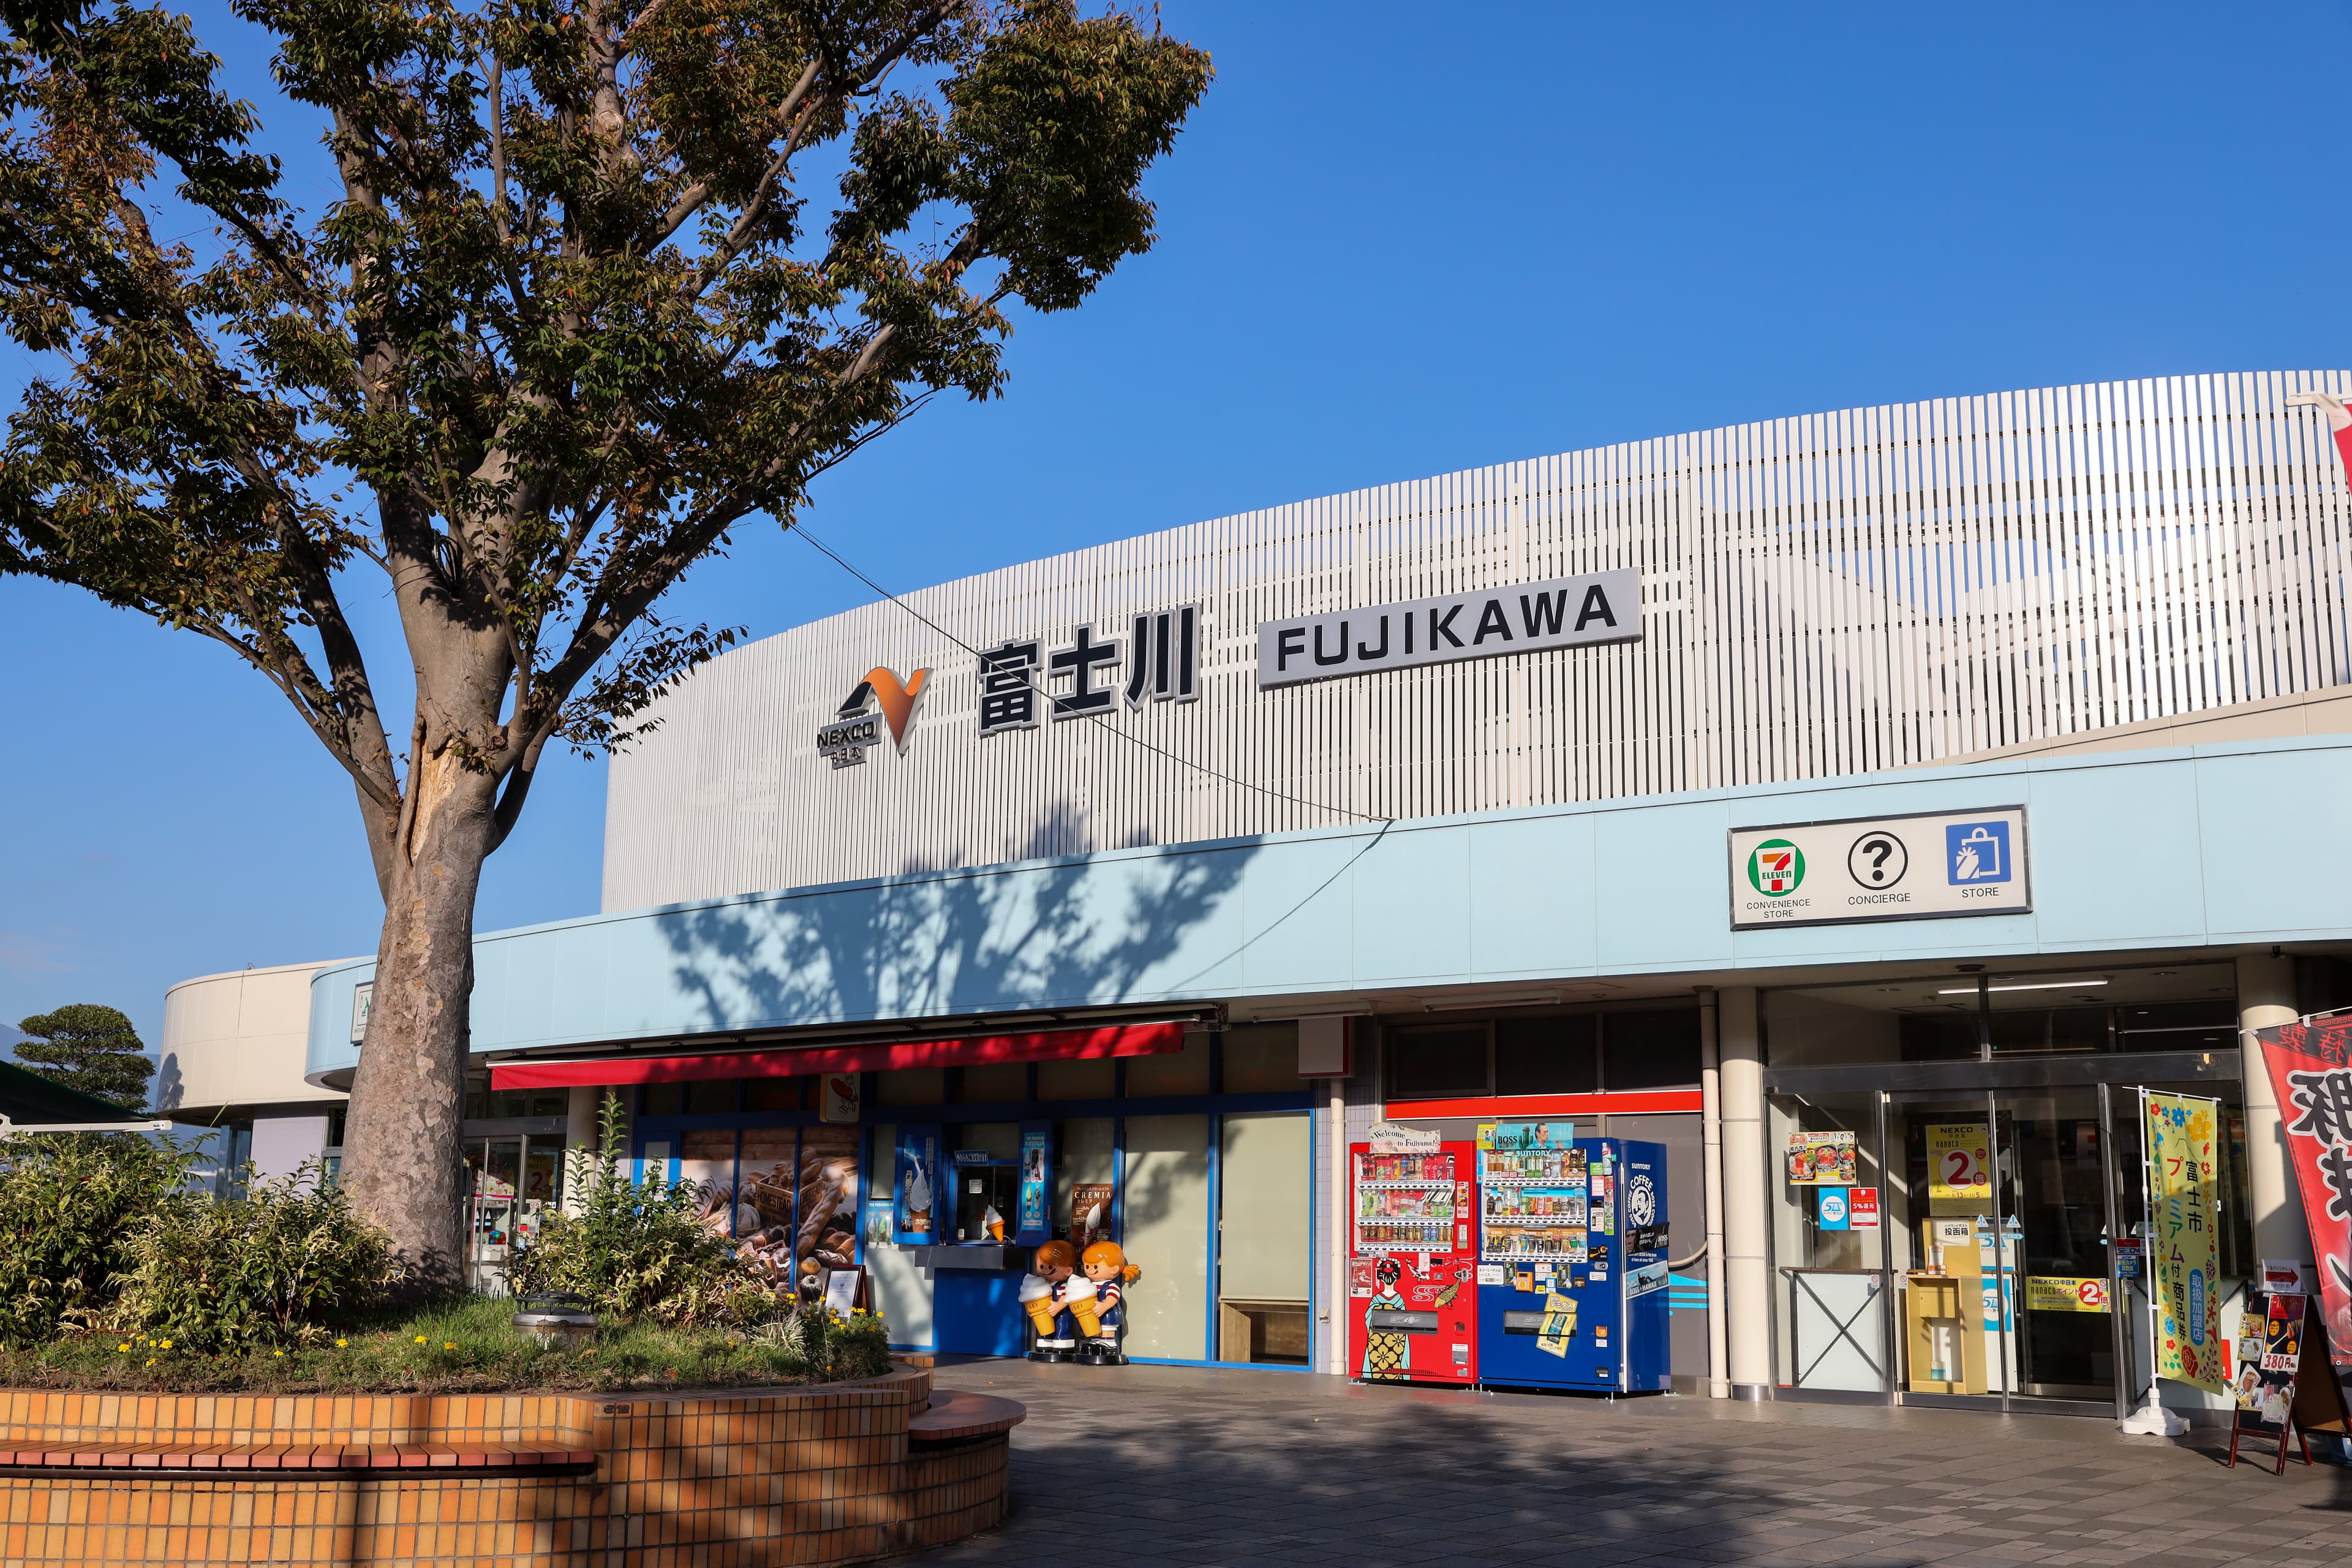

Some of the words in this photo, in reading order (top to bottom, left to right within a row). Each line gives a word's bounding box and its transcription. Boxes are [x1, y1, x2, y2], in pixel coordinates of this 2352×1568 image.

[1278, 584, 1617, 671] FUJIKAWA
[979, 605, 1196, 732] 富士川
[817, 721, 875, 748] NEXCO
[831, 746, 861, 761] 中日本
[1762, 852, 1791, 892] 7
[1848, 892, 1911, 905] CONCIERGE
[1962, 887, 1999, 898] STORE
[1746, 899, 1811, 910] CONVENIENCE
[1764, 910, 1794, 919] STORE
[1374, 1129, 1406, 1139] Welcome
[1405, 1139, 1435, 1147] Fujiyama!
[1948, 1152, 1972, 1185] 2
[1630, 1174, 1653, 1191] COFFEE
[1975, 1174, 1985, 1184] 倍
[758, 1189, 791, 1210] HOMESTEAD
[2186, 1160, 2203, 1233] 富士市
[1945, 1227, 1969, 1236] 投函箱
[2167, 1156, 2187, 1341] プレミアム付商品券
[1629, 1286, 1640, 1295] BOSS
[2082, 1284, 2098, 1303] 2
[2192, 1275, 2203, 1341] 取扱加盟店
[2264, 1354, 2291, 1370] 380円
